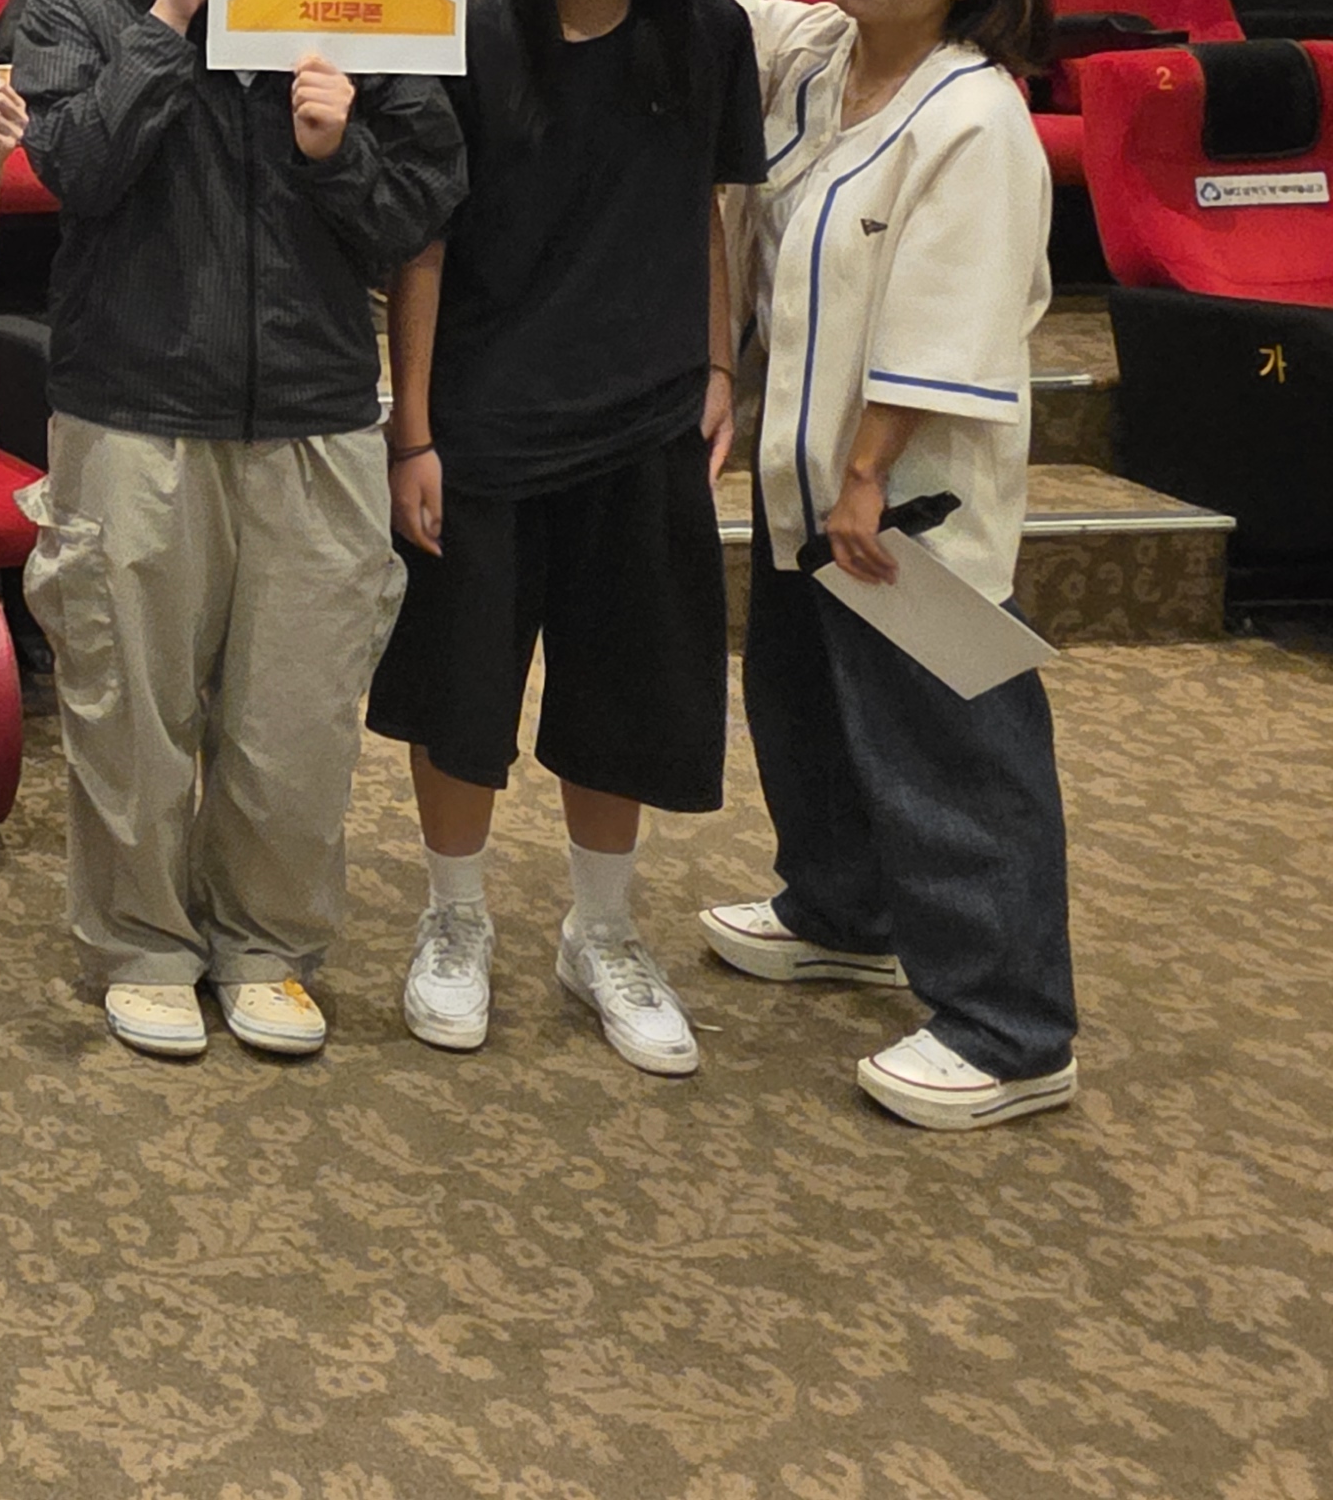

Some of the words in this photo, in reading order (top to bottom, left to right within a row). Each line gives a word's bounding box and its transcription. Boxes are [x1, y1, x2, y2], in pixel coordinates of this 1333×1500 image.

[299, 1, 383, 23] 치킨쿠폰
[1156, 66, 1173, 91] 2
[1258, 344, 1287, 383] 가
